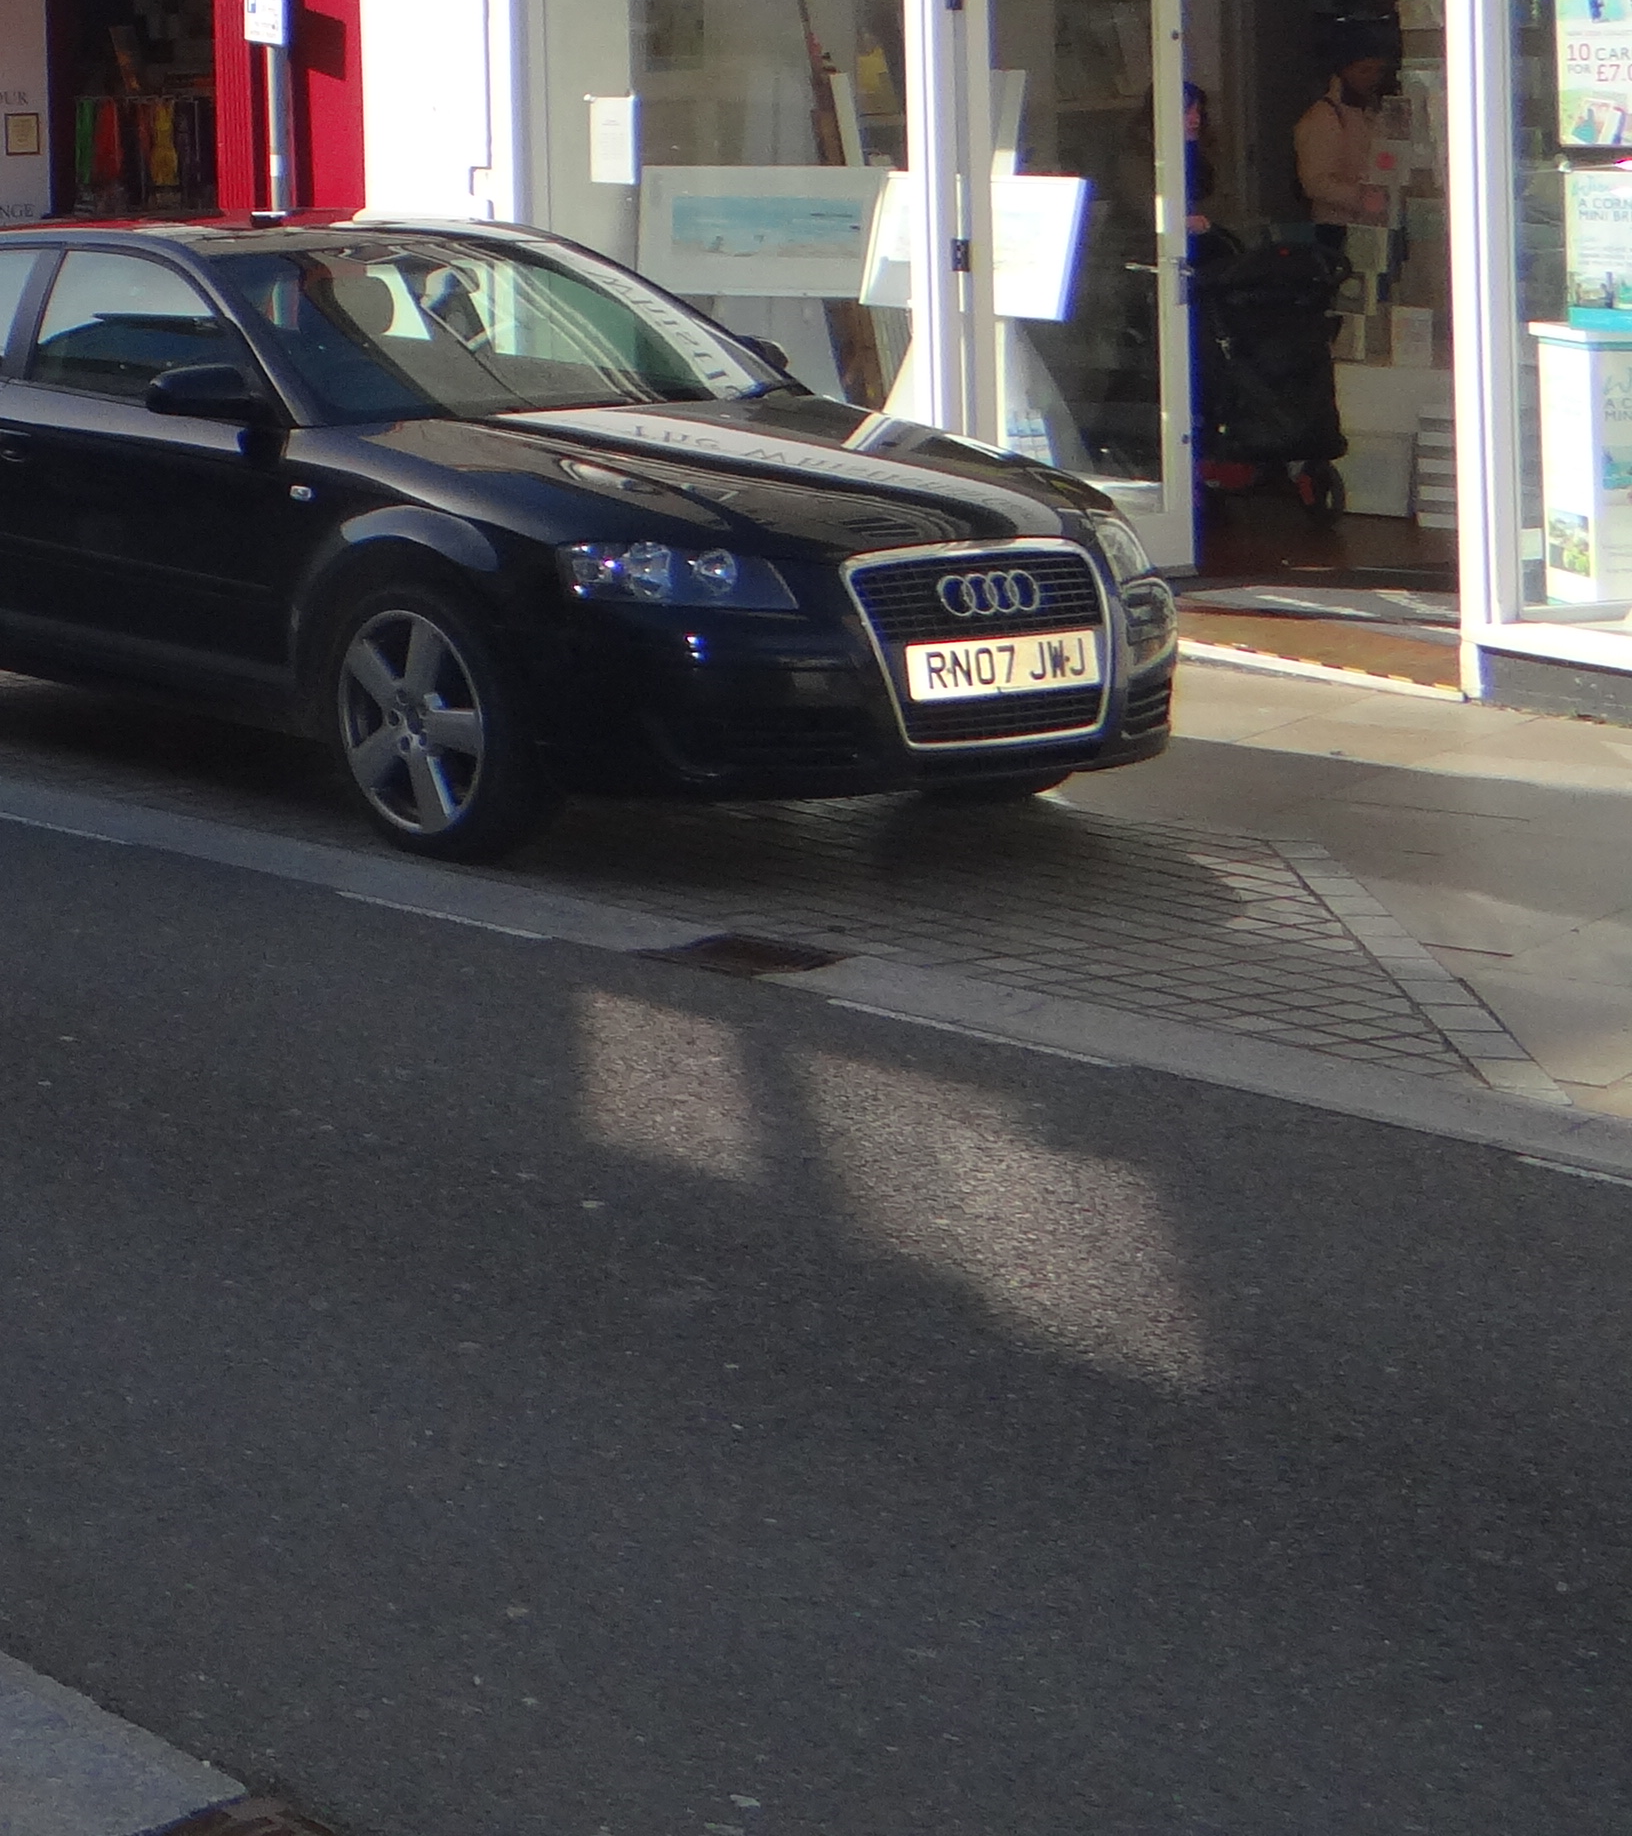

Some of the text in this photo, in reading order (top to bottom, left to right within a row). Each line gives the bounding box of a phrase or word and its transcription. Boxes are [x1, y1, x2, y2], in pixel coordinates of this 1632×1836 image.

[1566, 43, 1632, 61] 10 CAR
[1567, 64, 1591, 74] FOR
[925, 638, 1086, 690] RN07 JWJ
